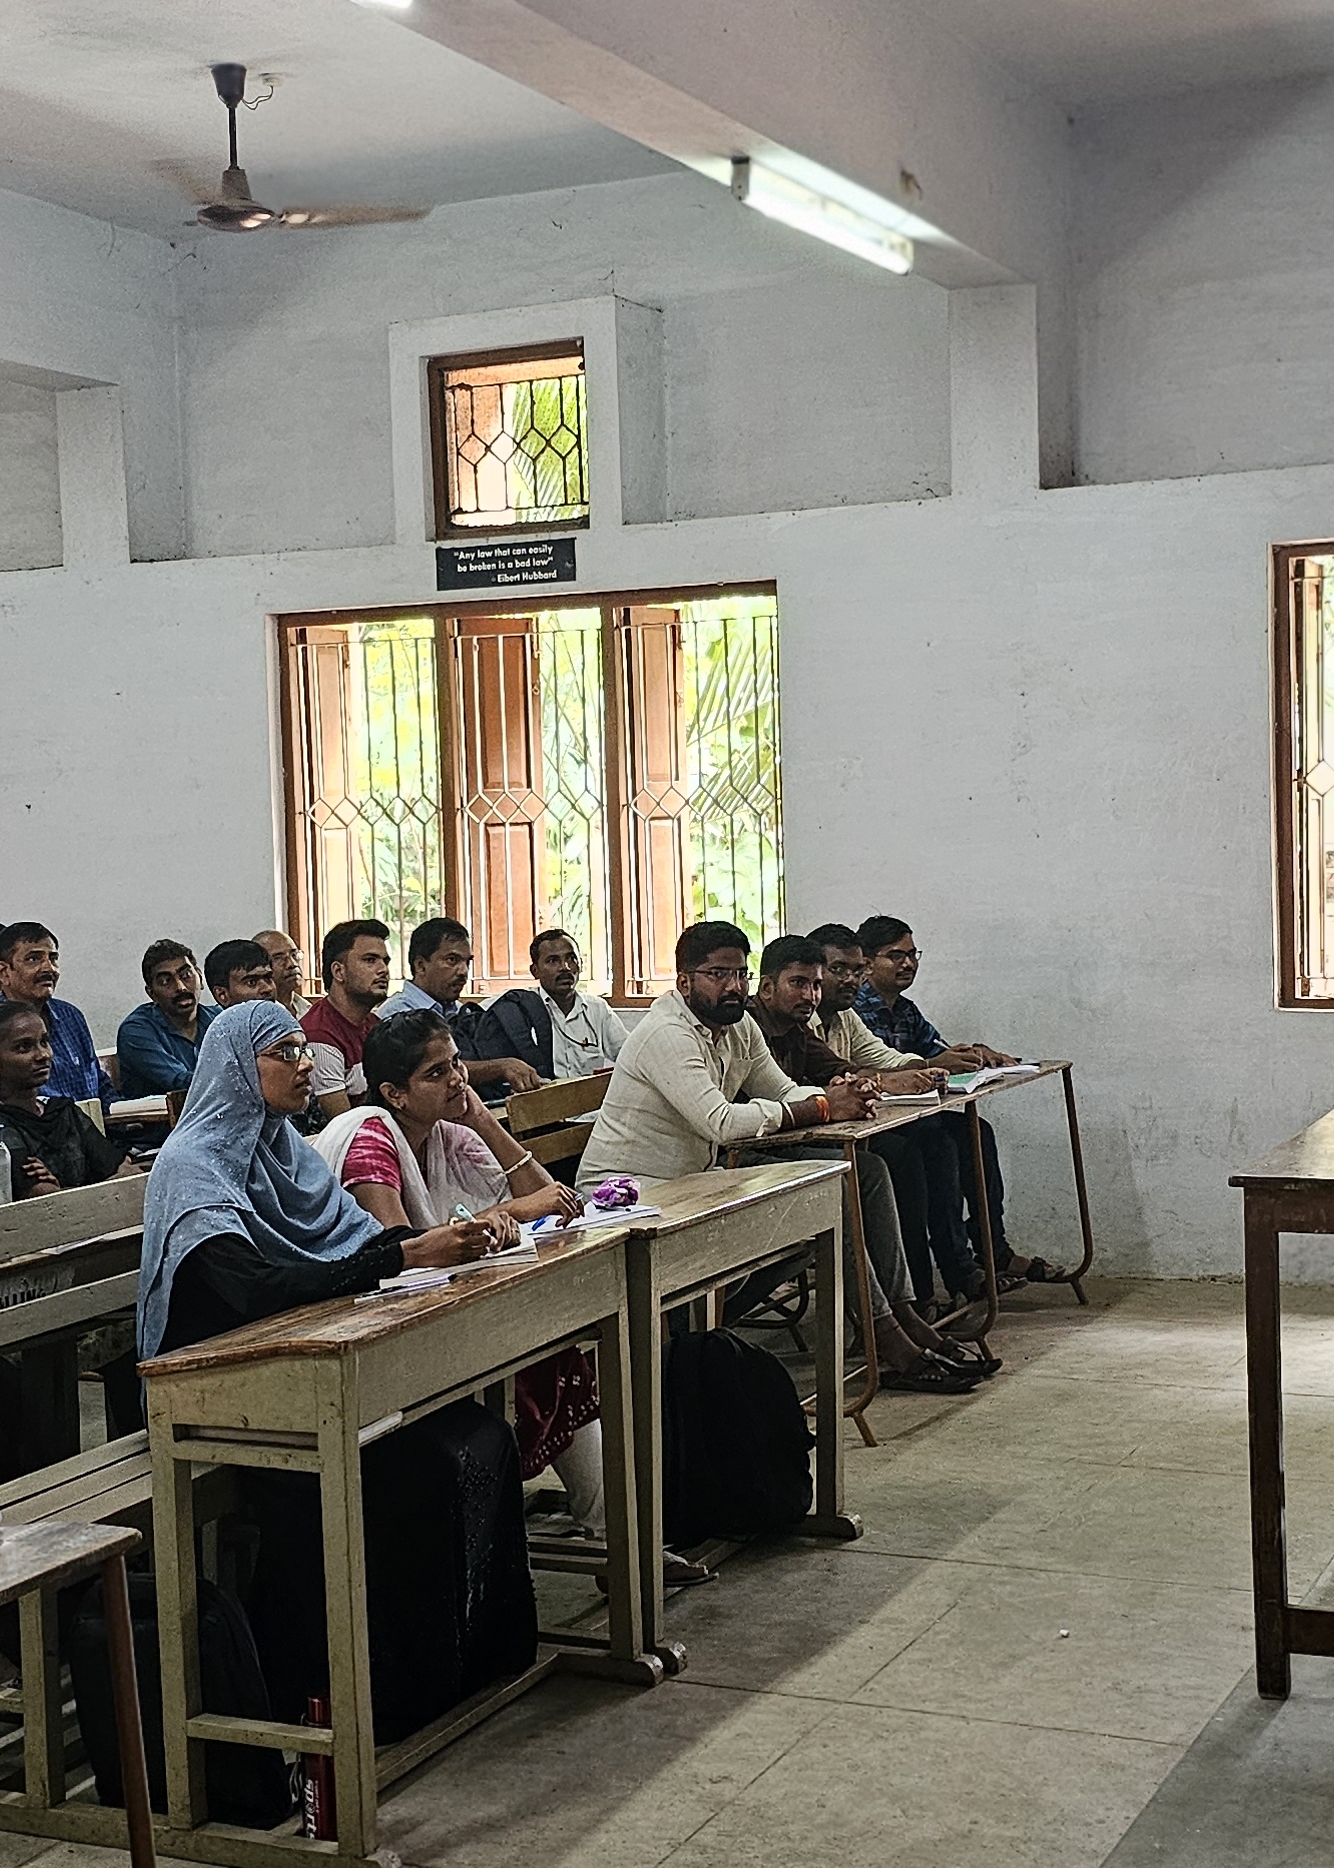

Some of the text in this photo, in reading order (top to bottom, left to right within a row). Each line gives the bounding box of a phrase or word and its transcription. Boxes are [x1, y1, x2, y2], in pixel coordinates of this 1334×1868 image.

[477, 549, 493, 559] law
[494, 547, 510, 557] that
[512, 548, 527, 556] can
[528, 544, 554, 556] easily
[457, 563, 468, 573] be
[469, 561, 497, 571] broken
[498, 560, 506, 569] is
[514, 557, 531, 568] bad
[522, 569, 557, 581] Hubbard
